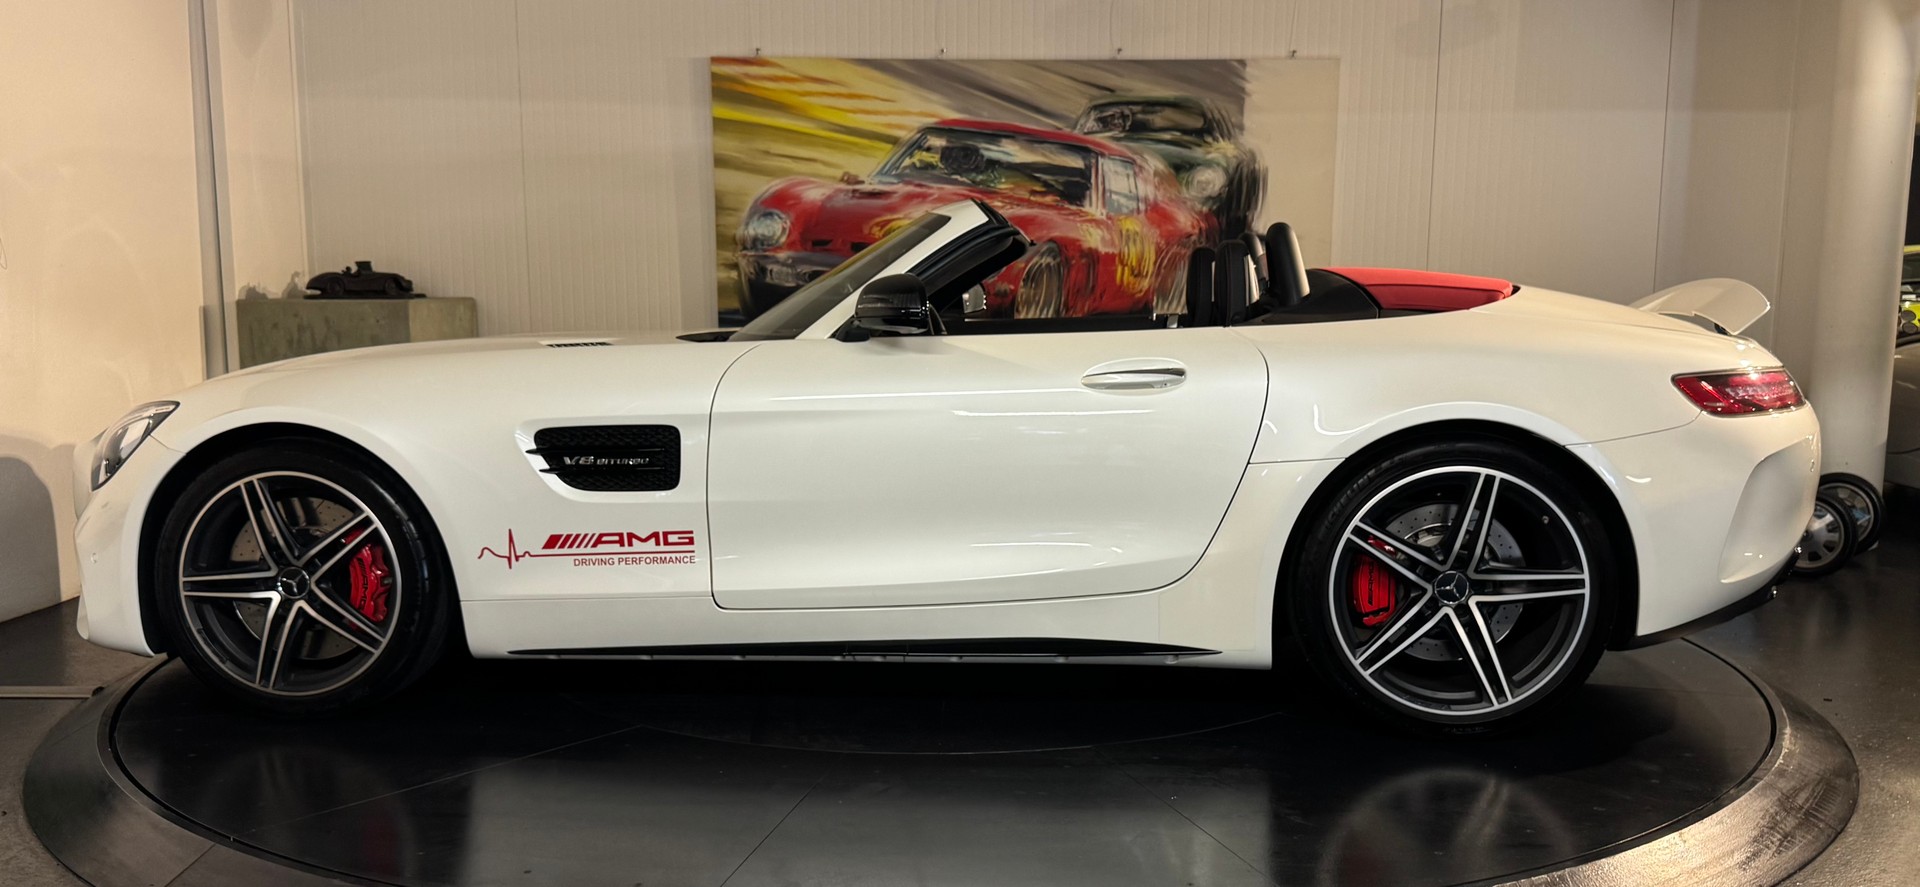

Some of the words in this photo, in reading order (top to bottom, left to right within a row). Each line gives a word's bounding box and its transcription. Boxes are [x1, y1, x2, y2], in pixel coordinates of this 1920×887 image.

[563, 456, 594, 465] V8
[591, 530, 695, 548] AMG
[573, 557, 615, 567] DRIVING
[618, 555, 696, 566] PERFORMANCE
